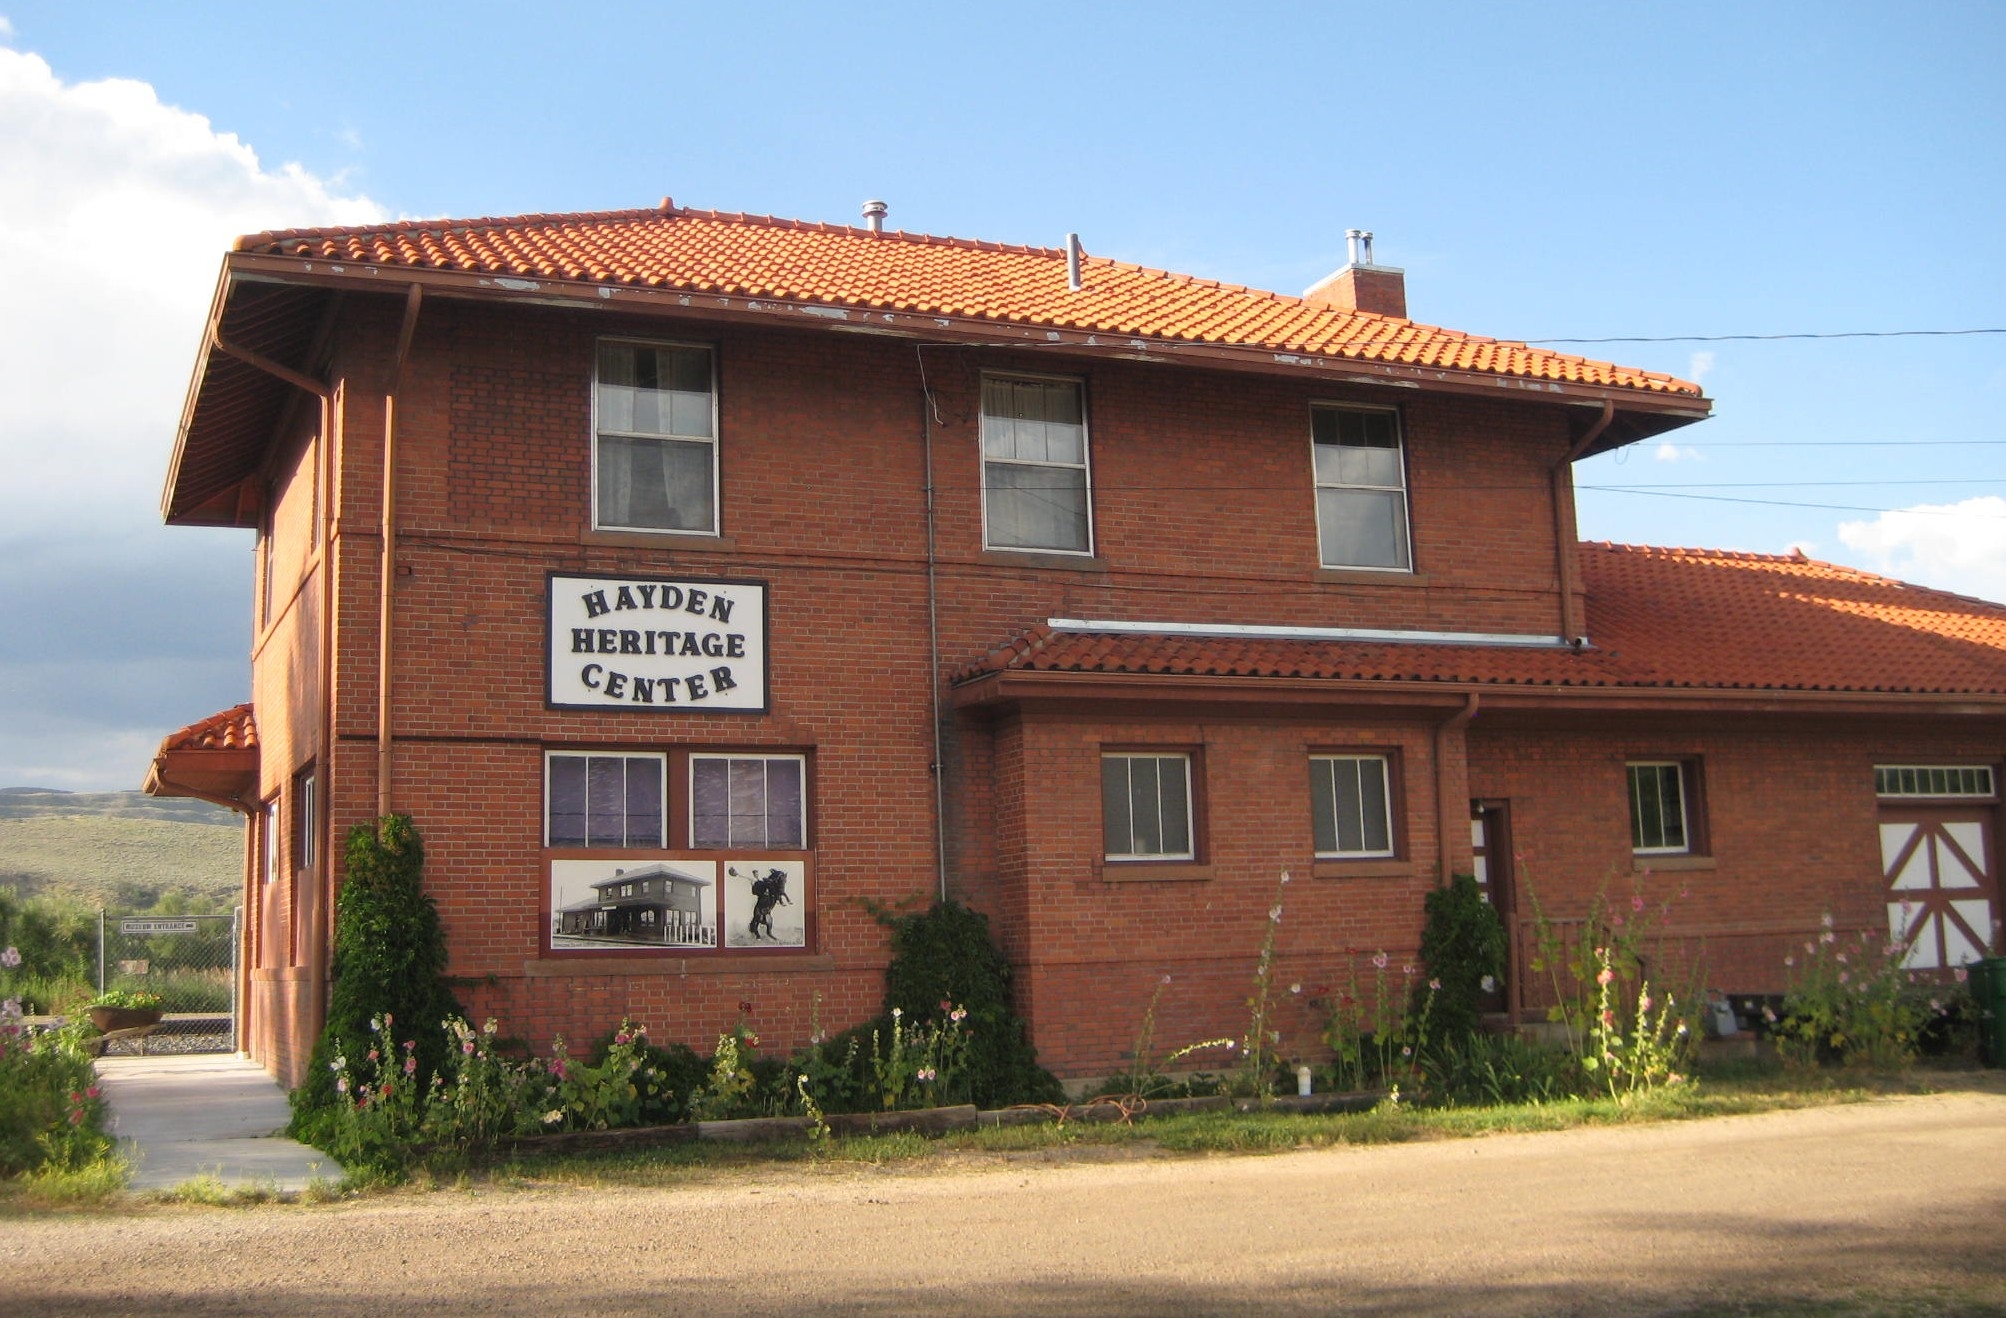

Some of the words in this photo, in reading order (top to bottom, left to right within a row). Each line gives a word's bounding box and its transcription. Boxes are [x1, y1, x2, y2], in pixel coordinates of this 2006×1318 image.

[581, 584, 735, 624] HAYDEN
[571, 628, 746, 658] HERITAGE
[581, 663, 738, 703] CENTER
[153, 922, 185, 930] ENTRANCE
